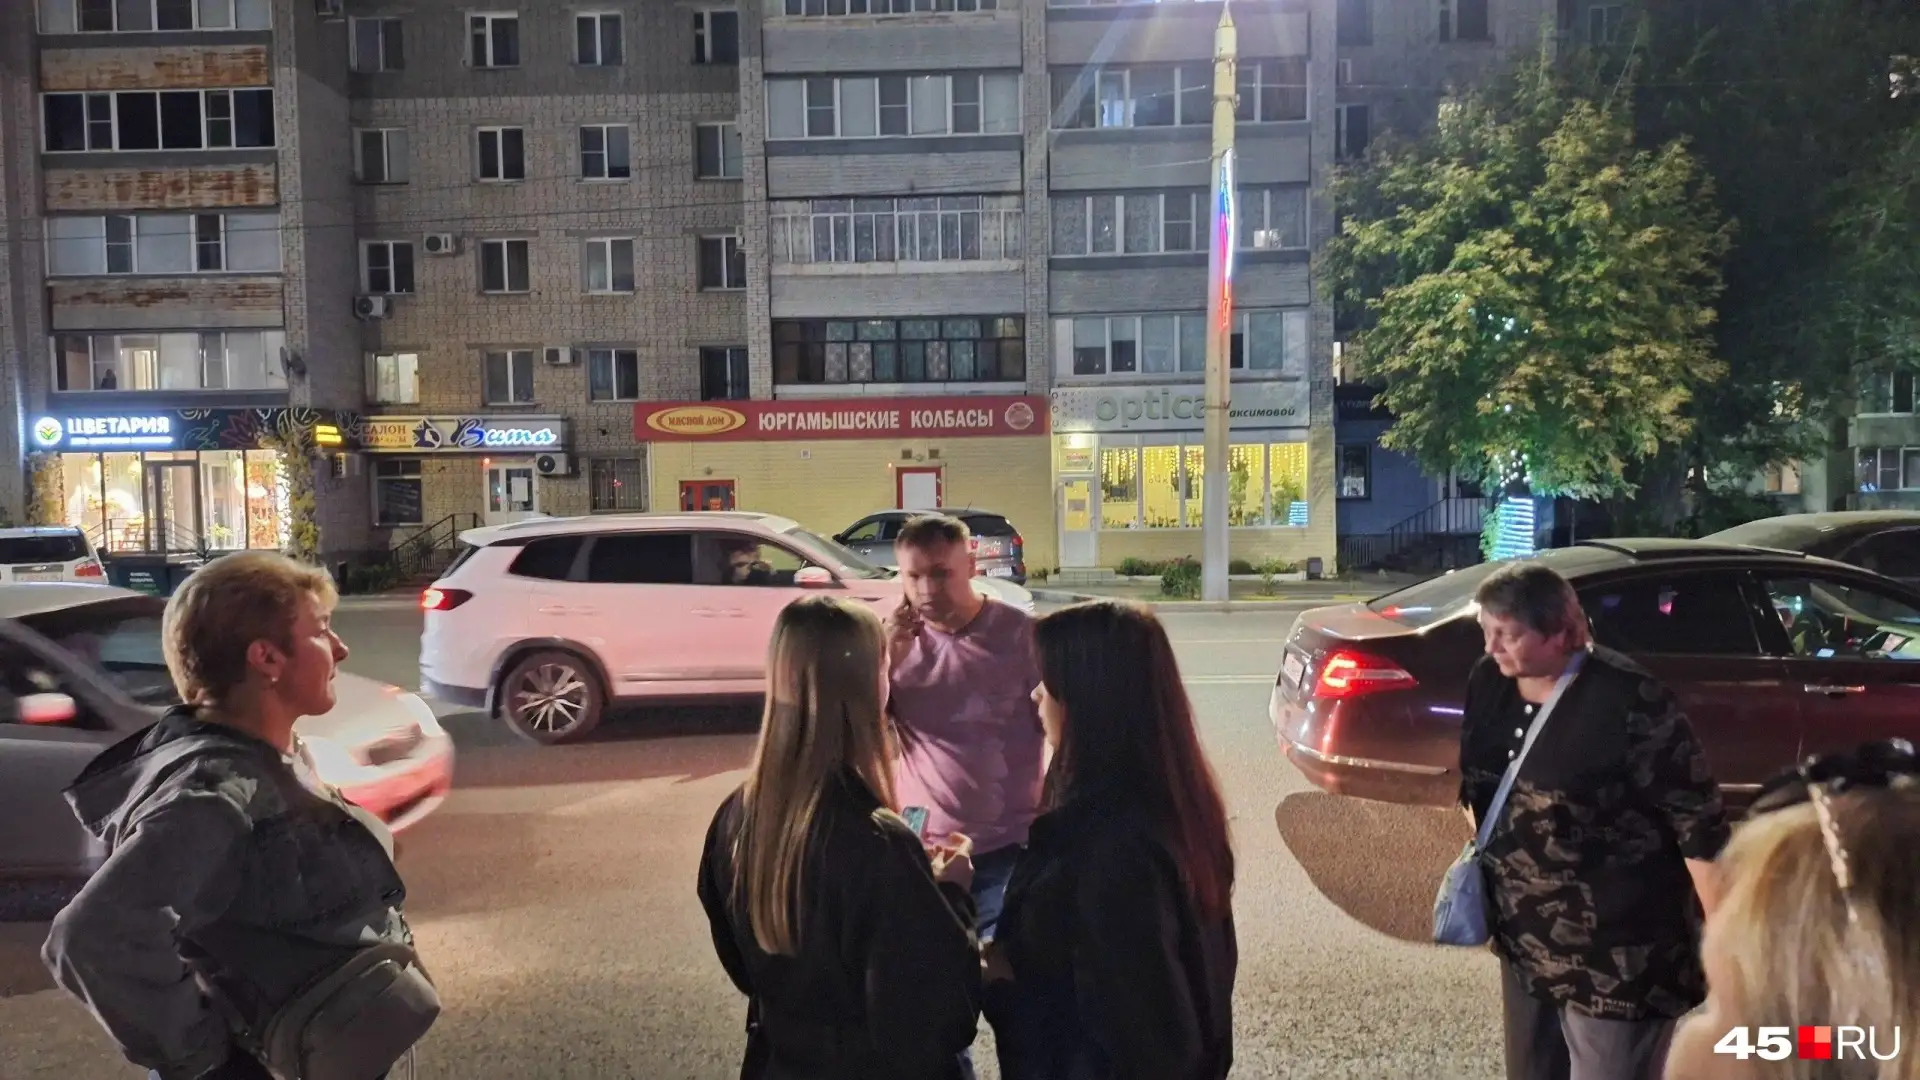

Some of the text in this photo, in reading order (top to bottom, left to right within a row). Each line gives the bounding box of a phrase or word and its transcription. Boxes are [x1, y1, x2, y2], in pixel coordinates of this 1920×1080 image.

[668, 414, 725, 426] МЯСНОЙ ДОМ
[758, 411, 900, 431] ЮРГАМЫШСКИЕ
[911, 409, 994, 429] КОЛБАСЫ
[1230, 408, 1298, 419] аксимовой
[67, 416, 170, 434] ЦВЕТАРИЯ
[362, 424, 406, 435] САЛОН
[450, 418, 558, 448] Вита
